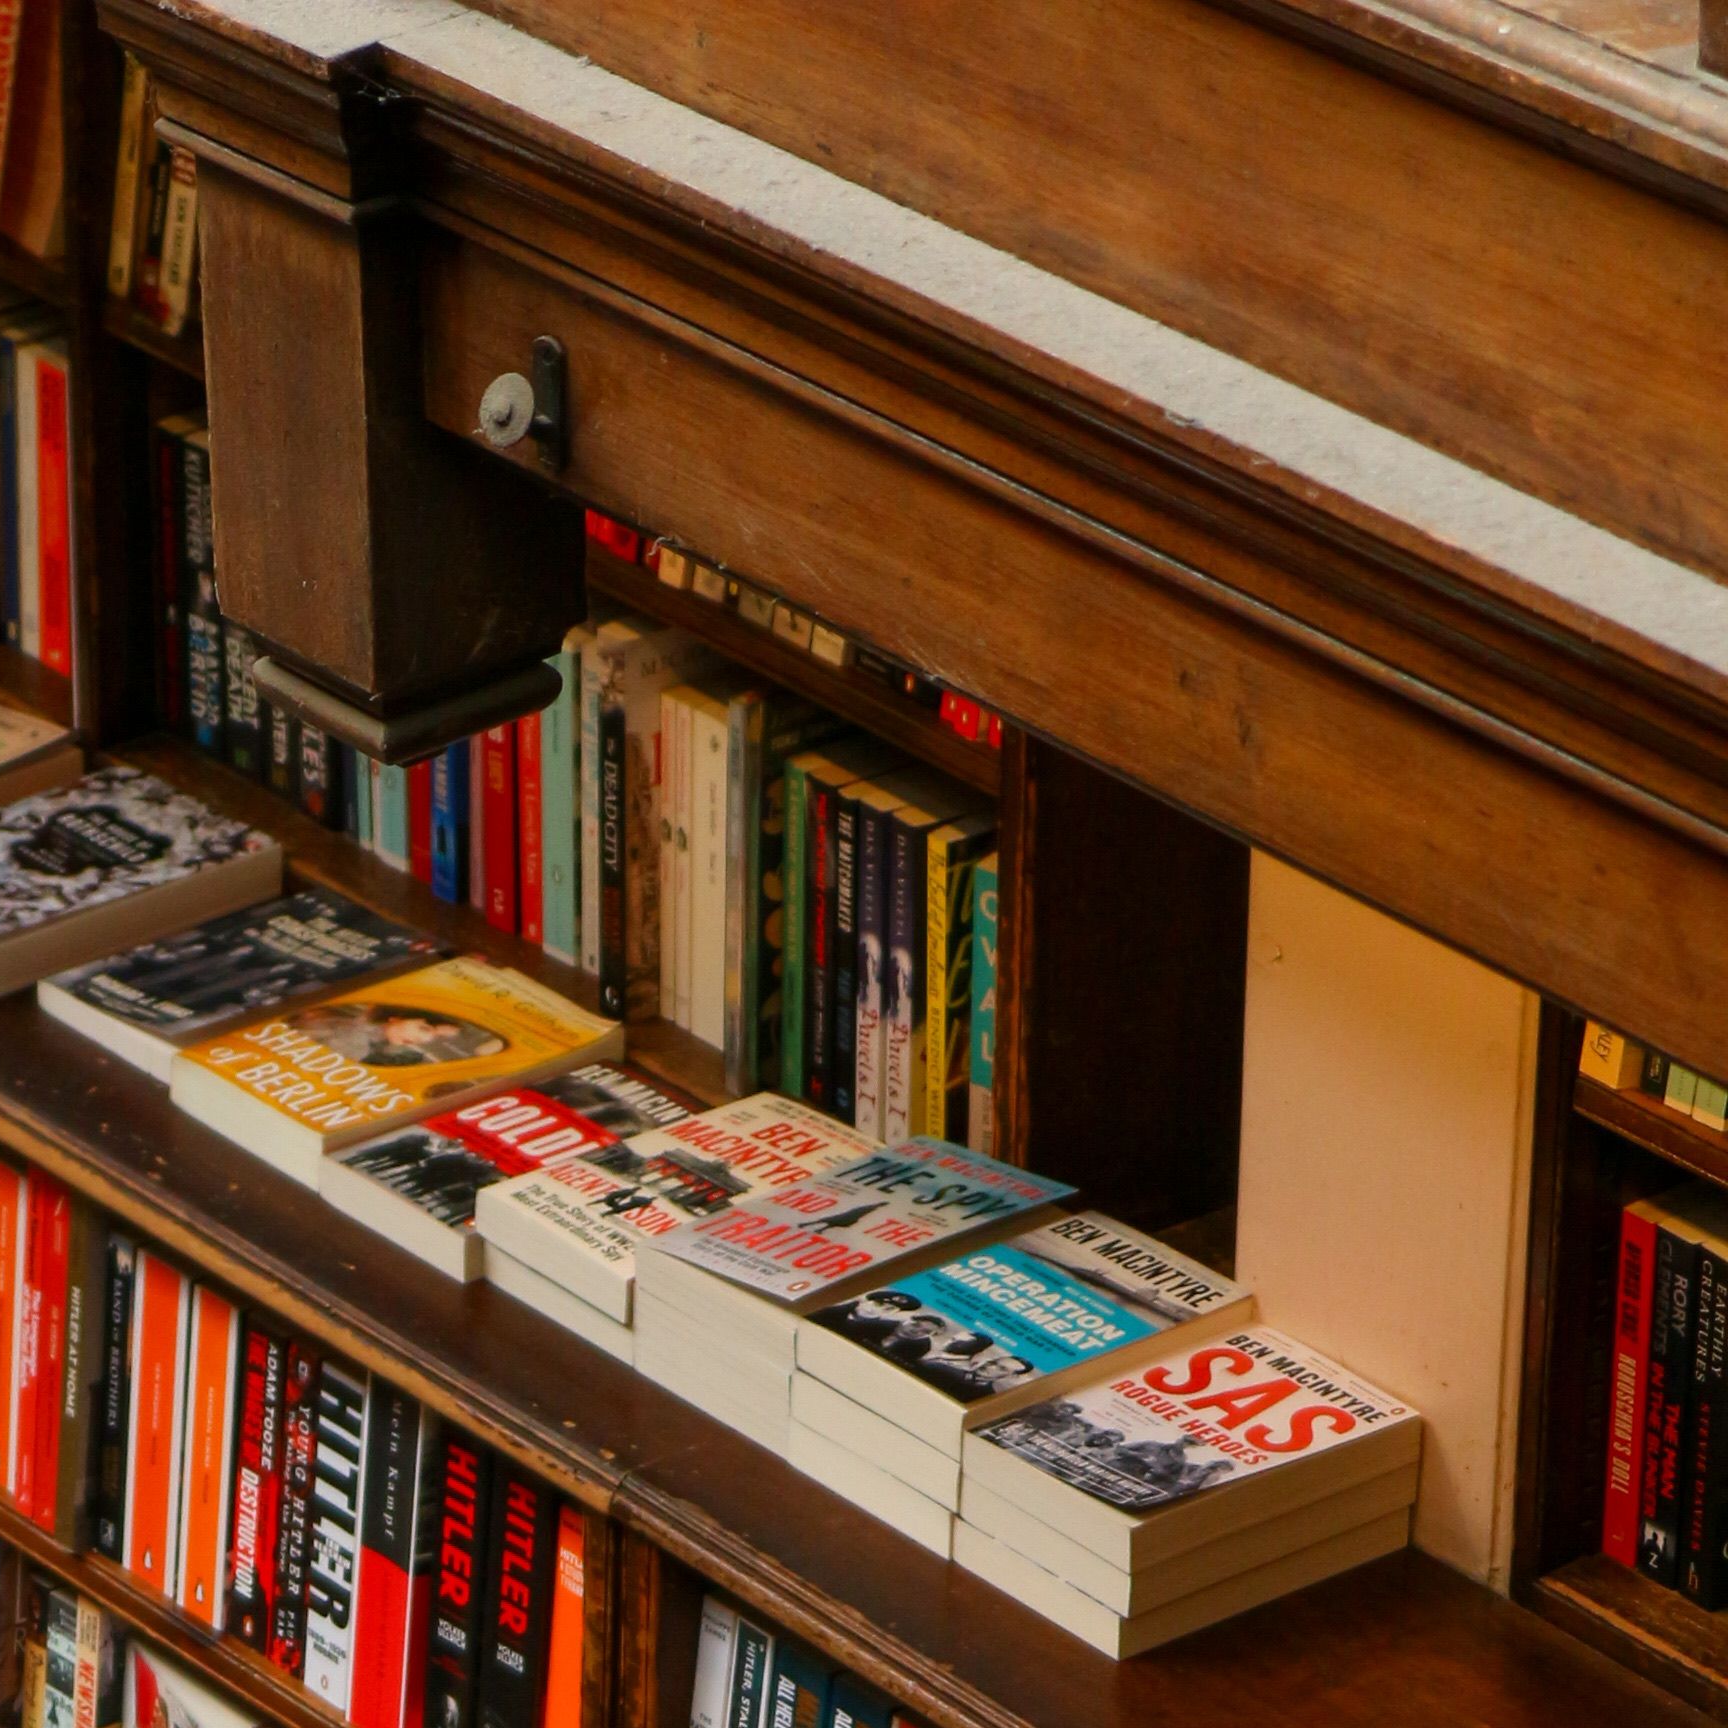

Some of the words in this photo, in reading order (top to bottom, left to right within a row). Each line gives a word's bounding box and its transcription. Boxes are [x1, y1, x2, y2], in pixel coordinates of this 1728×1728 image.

[208, 1045, 240, 1071] of
[237, 1049, 364, 1129] BERLIN
[244, 1022, 415, 1115] SHADOWS
[770, 1190, 823, 1215] AND
[833, 1158, 916, 1194] THE
[919, 1175, 1005, 1220] SPY
[861, 1218, 937, 1249] THE
[696, 1210, 873, 1279] TRAITOR
[1047, 1218, 1091, 1246] BEN
[1092, 1238, 1223, 1309] MACINTYRE
[937, 1263, 1110, 1352] MINCEMEAT
[965, 1255, 1128, 1342] OPERATION
[1109, 1378, 1181, 1426] ROGUE
[1183, 1420, 1269, 1467] HEROES
[1142, 1348, 1359, 1455] SAS
[1225, 1335, 1272, 1364] BEN
[1269, 1355, 1390, 1426] MACINTYRE
[236, 1466, 260, 1599] DESTRUCTION
[439, 1443, 478, 1607] HITLER
